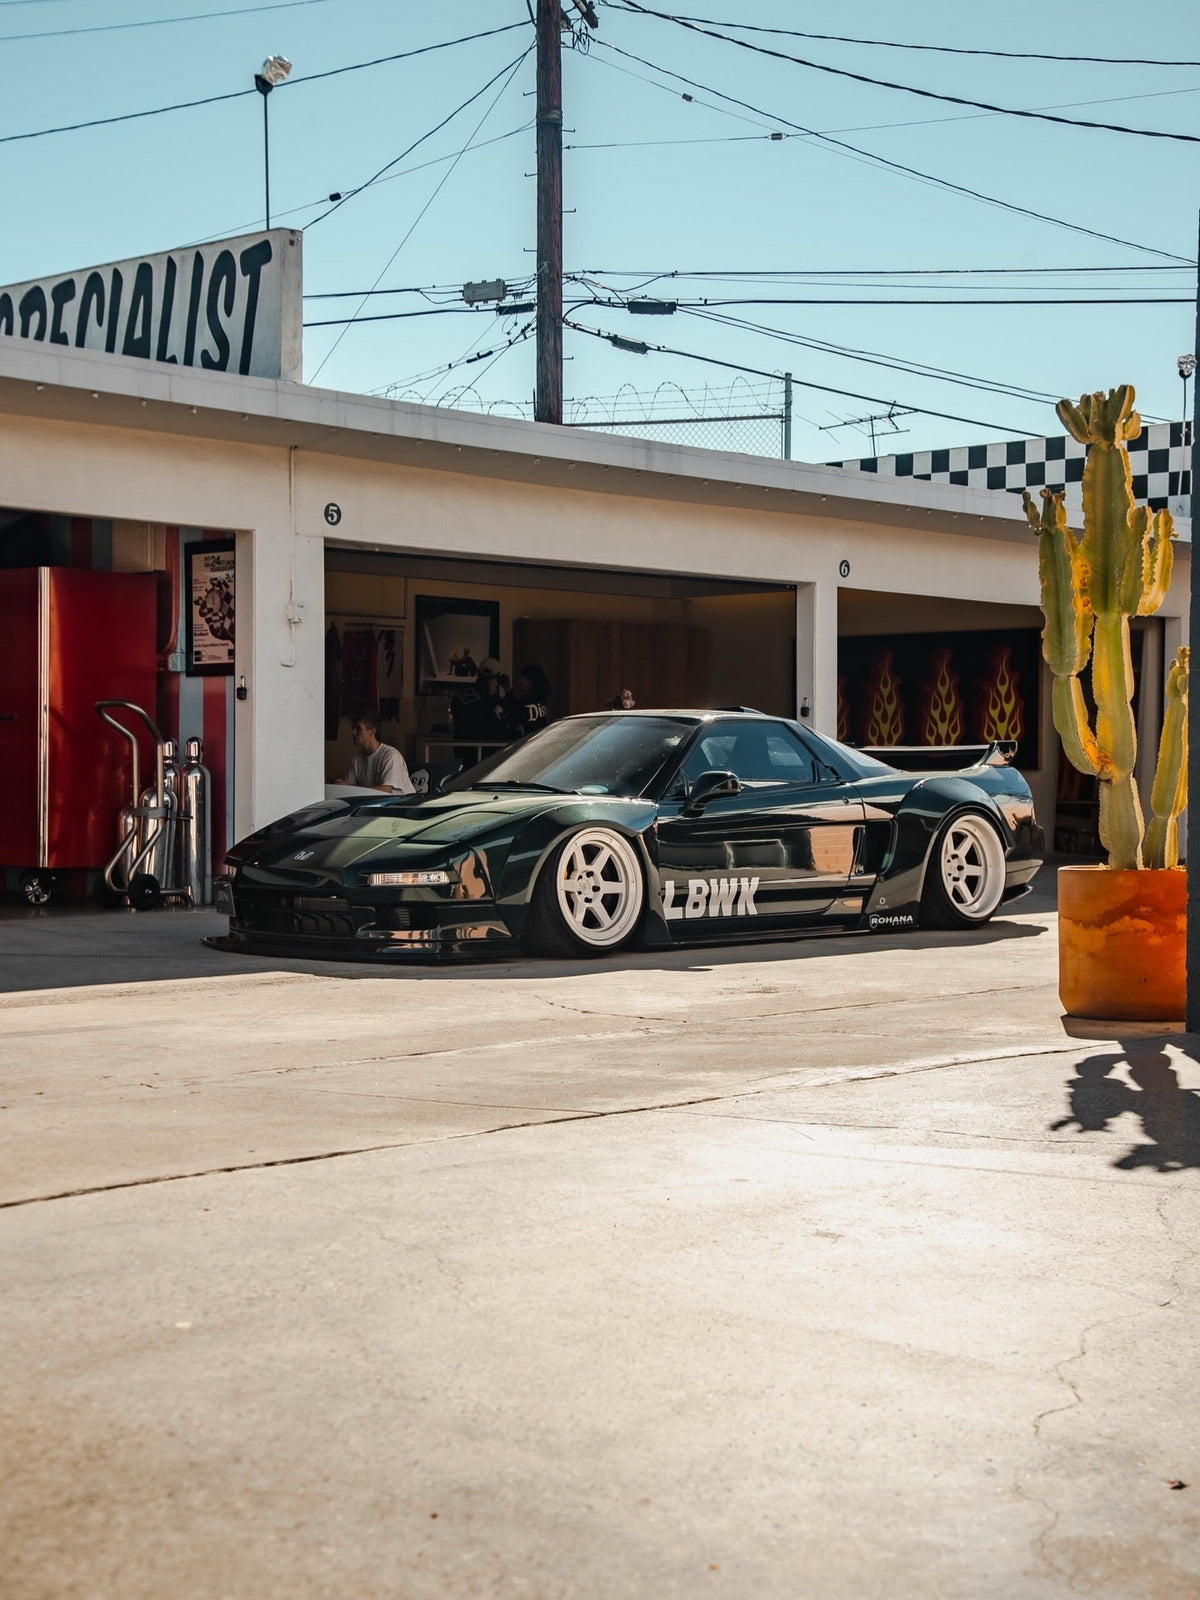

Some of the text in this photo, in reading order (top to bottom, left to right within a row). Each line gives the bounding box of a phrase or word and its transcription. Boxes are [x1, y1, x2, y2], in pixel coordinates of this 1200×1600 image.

[326, 504, 339, 523] 5
[841, 561, 849, 577] 6
[664, 877, 760, 921] LBWK
[871, 915, 914, 925] ROHANA
